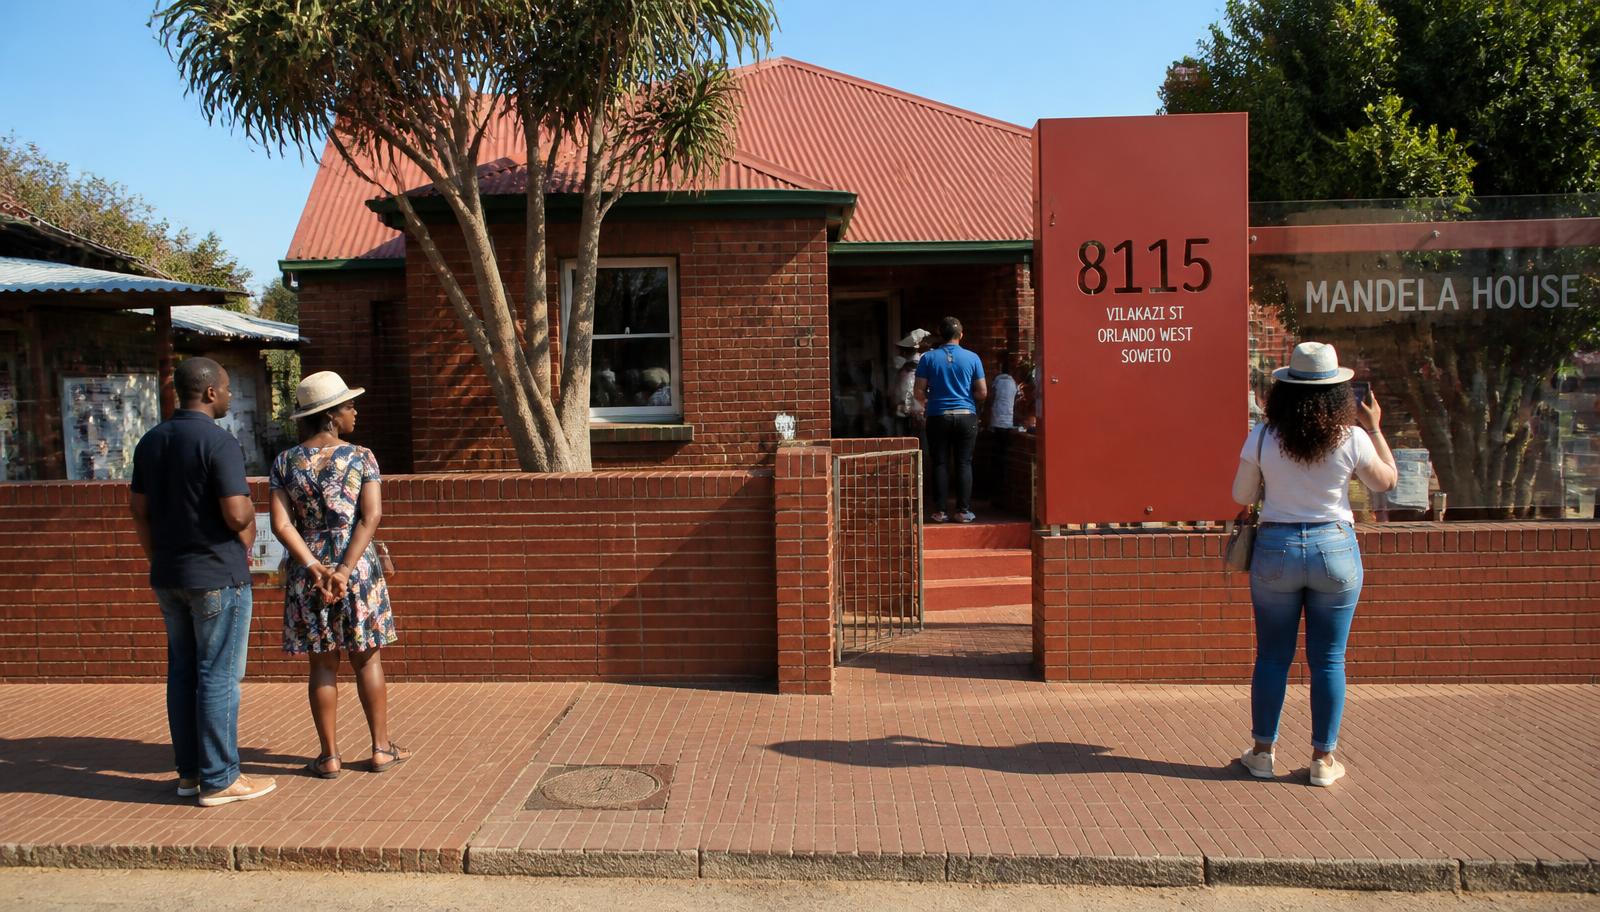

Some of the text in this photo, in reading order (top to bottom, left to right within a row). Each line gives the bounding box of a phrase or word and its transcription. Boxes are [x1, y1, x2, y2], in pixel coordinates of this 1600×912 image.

[1077, 237, 1213, 296] 8115
[1306, 273, 1580, 314] MANDELA HOUSE
[1106, 305, 1184, 321] VILAKAZI ST
[1097, 326, 1192, 343] ORLANDO WEST
[1121, 348, 1172, 364] SOWETO
